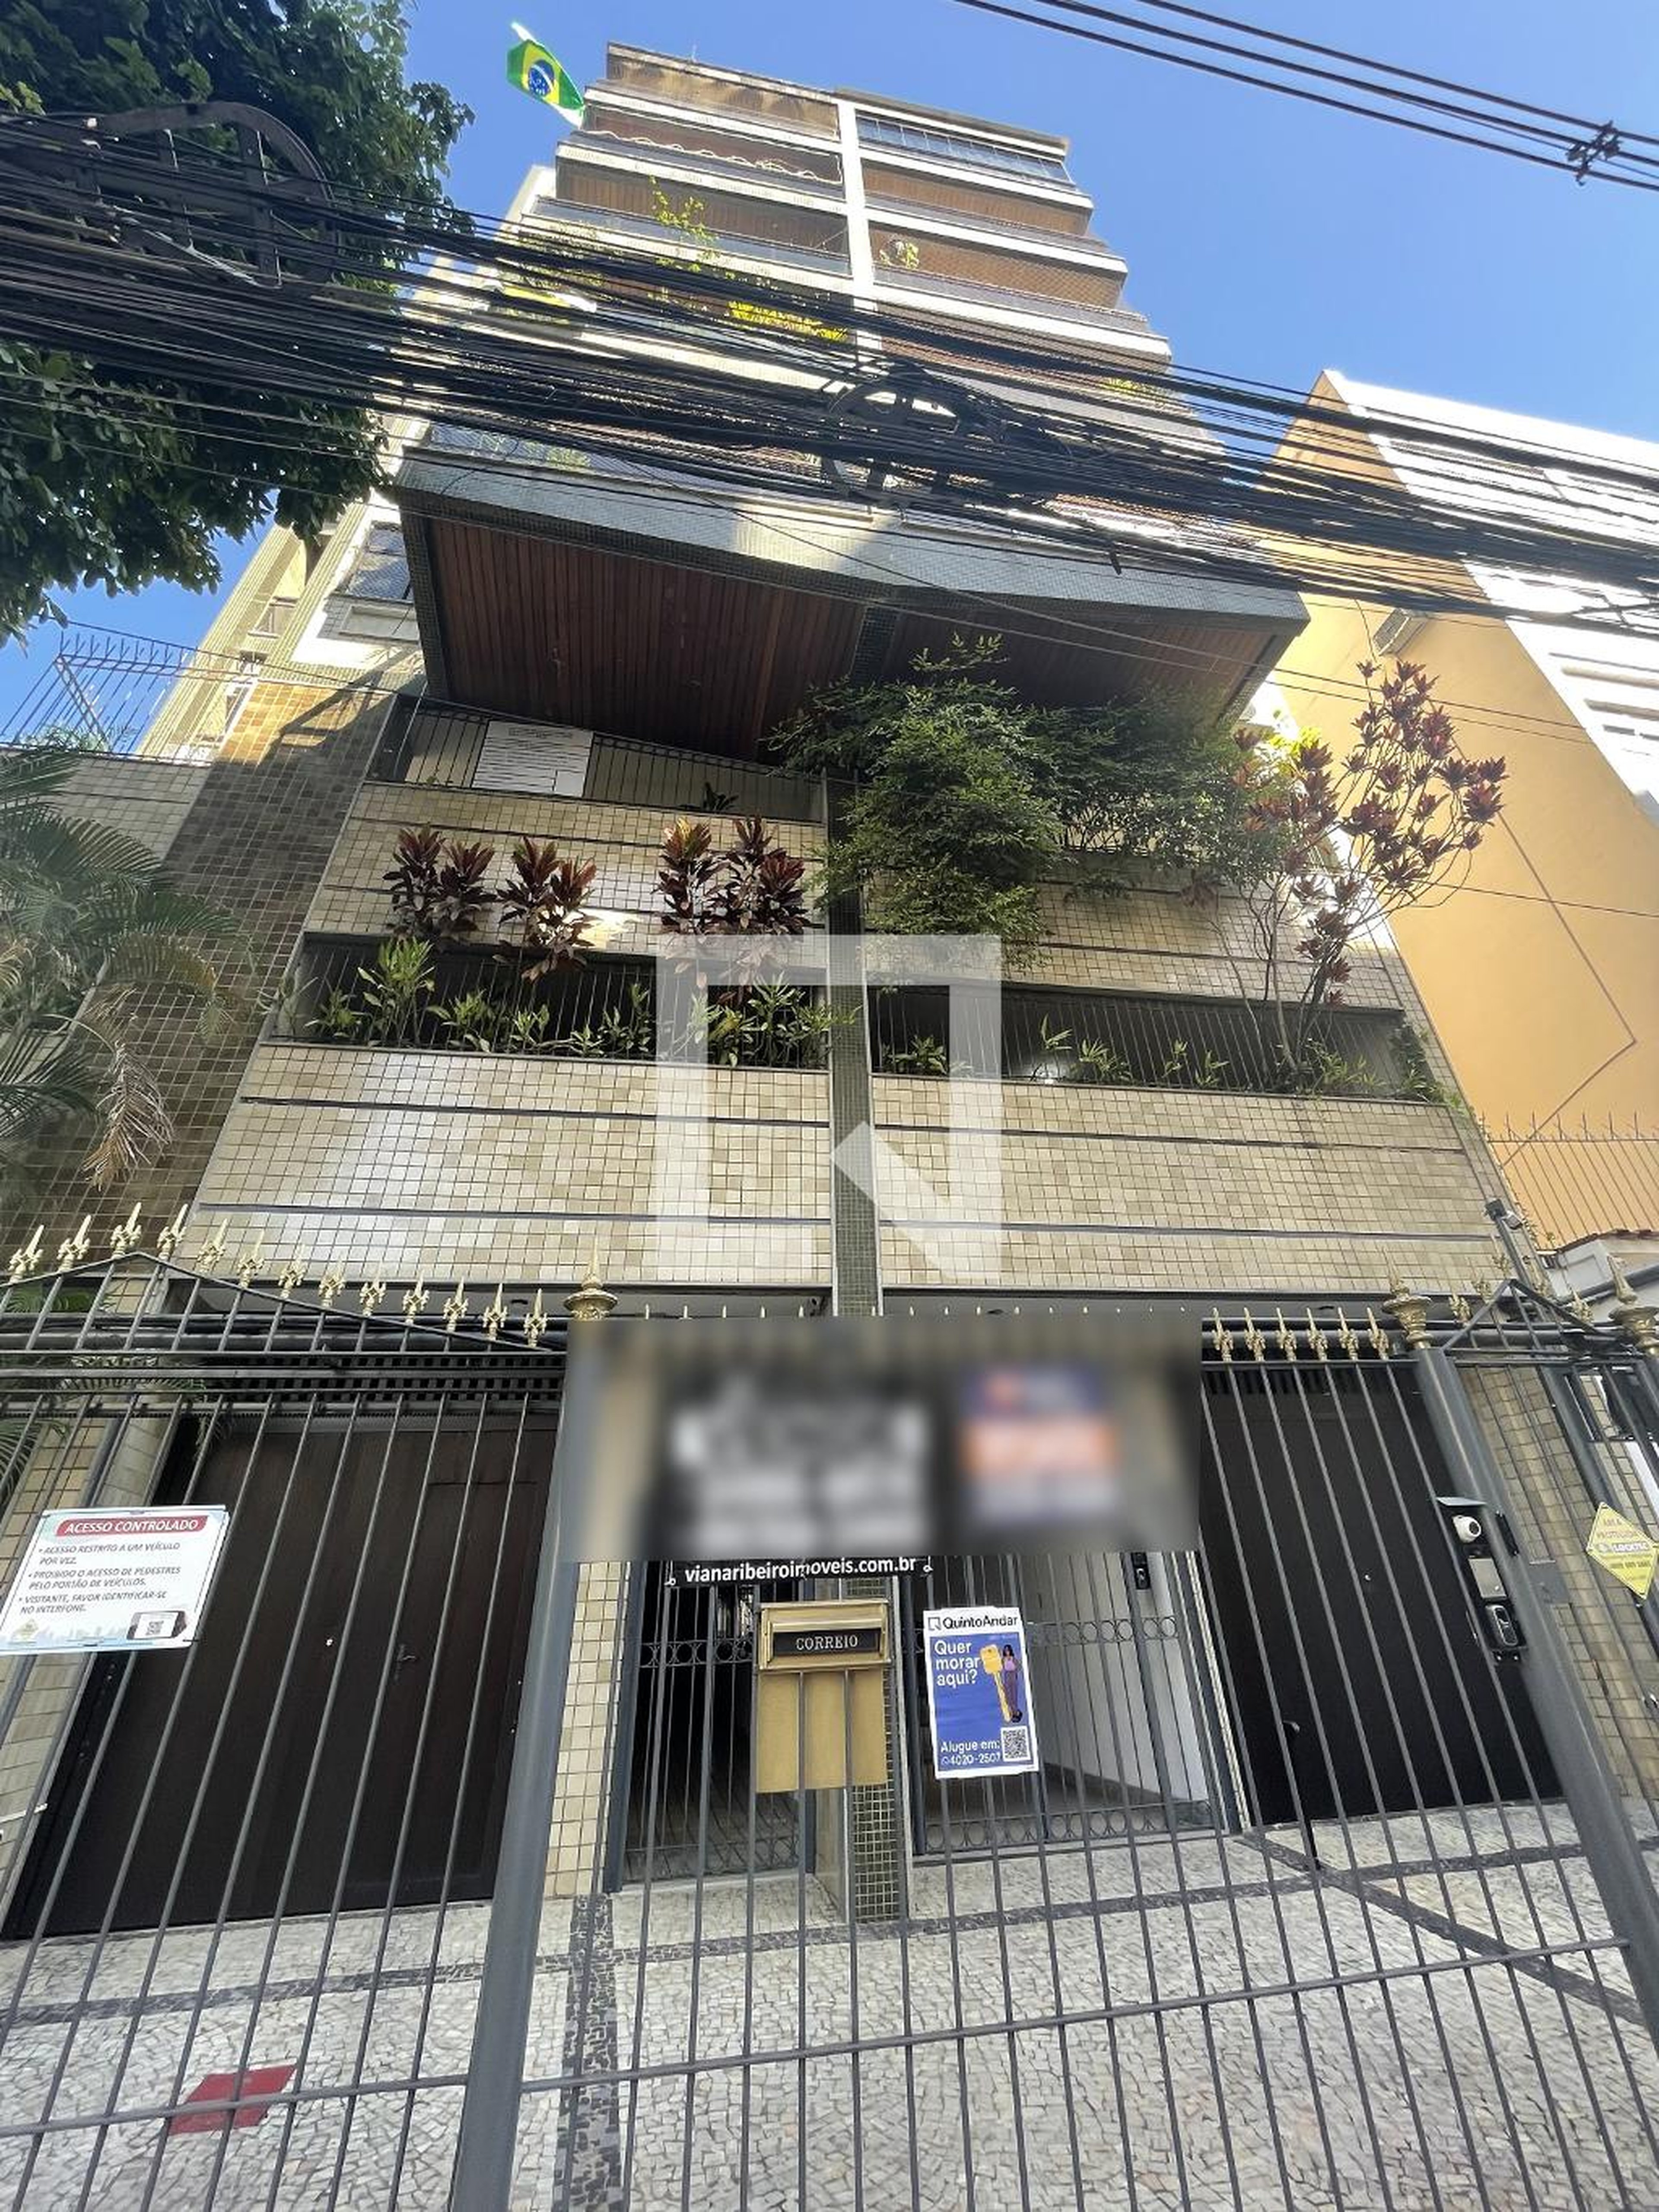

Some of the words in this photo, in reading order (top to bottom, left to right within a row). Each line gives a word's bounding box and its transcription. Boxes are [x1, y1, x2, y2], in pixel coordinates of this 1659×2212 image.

[64, 1521, 113, 1534] ACESSO
[115, 1519, 199, 1532] CONTROLADO
[44, 1545, 77, 1554] ACESSO
[78, 1544, 118, 1553] RESTRITO
[127, 1544, 143, 1552] UM
[145, 1541, 181, 1551] VEÍCULO
[39, 1557, 58, 1565] POR
[86, 1568, 120, 1577] ACESSO
[134, 1566, 181, 1575] PEDESTRES
[685, 1556, 916, 1582] vianaribeiroimoveis.com.br
[29, 1581, 51, 1590] PELO
[52, 1578, 88, 1589] PORTÃO
[102, 1591, 167, 1601] IDENTIFICAR-SE
[20, 1605, 35, 1614] NO
[942, 1615, 1018, 1629] QuintoAndar
[796, 1634, 858, 1651] CORREIO
[934, 1640, 972, 1655] Quer
[936, 1656, 980, 1671] morar
[937, 1669, 978, 1689] aqui?
[941, 1741, 978, 1754] Alugue
